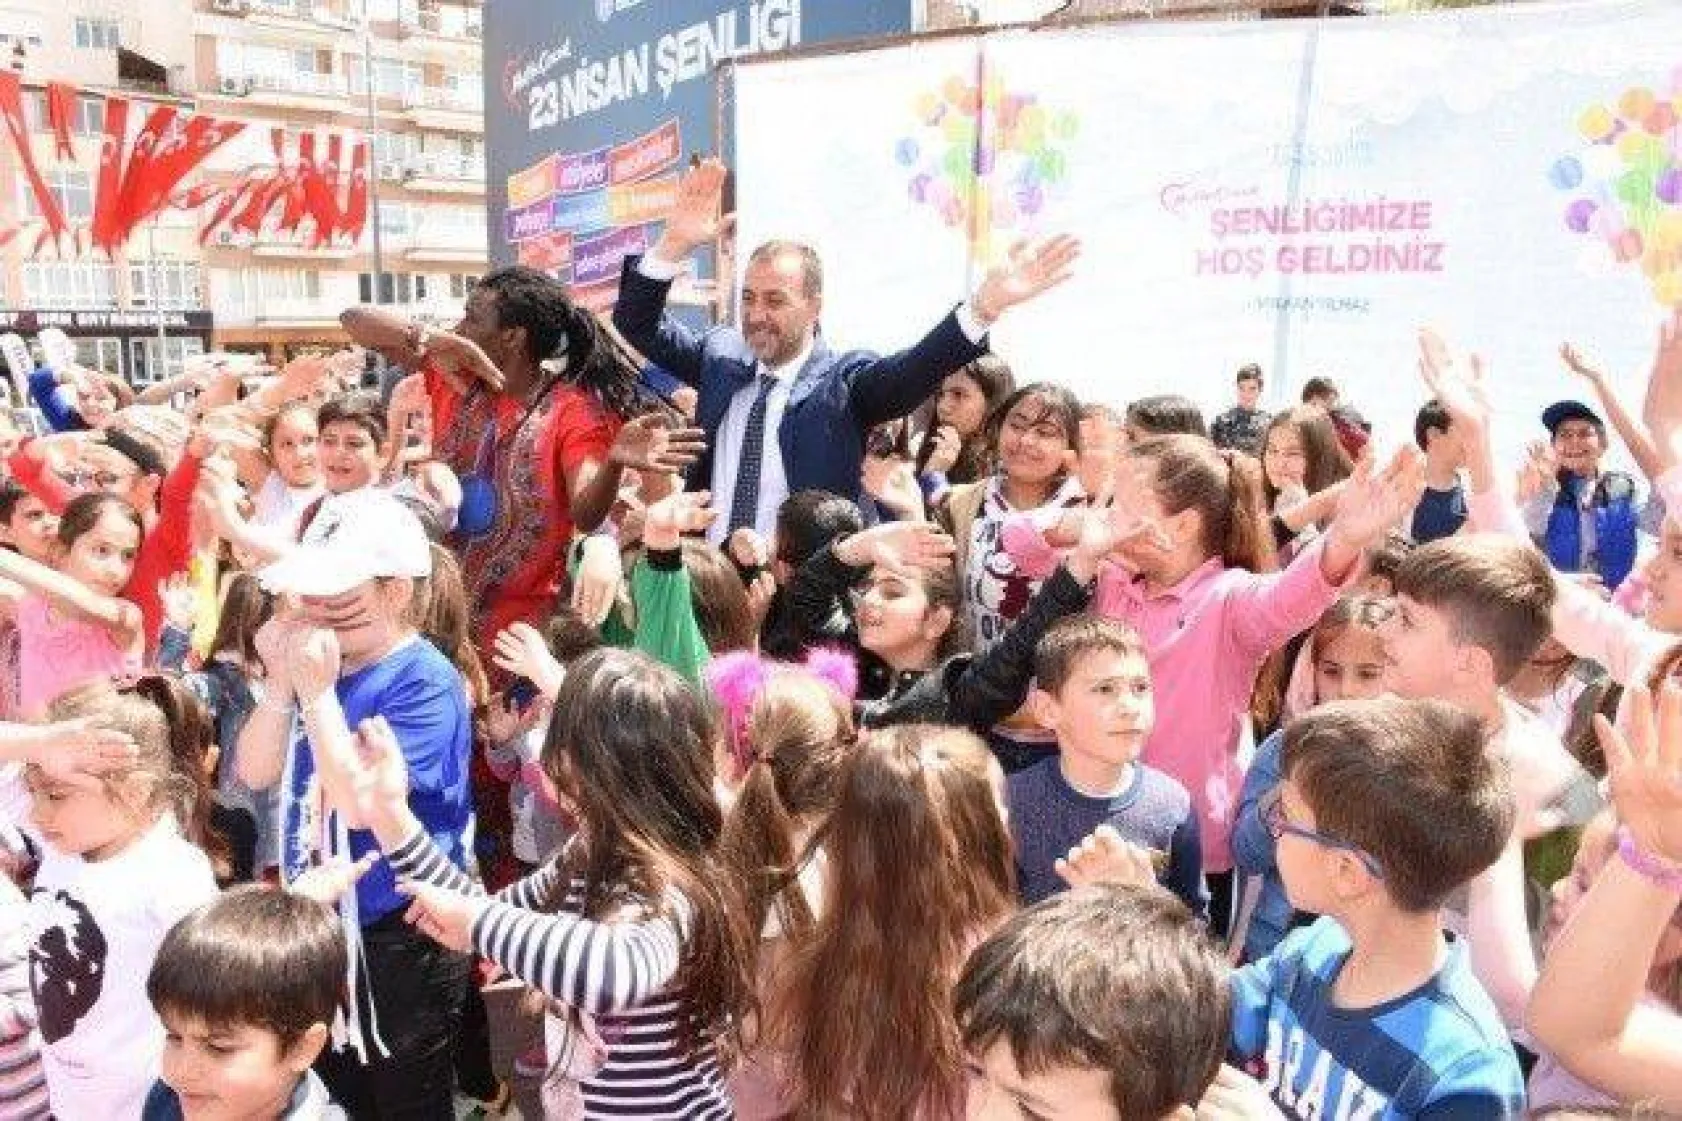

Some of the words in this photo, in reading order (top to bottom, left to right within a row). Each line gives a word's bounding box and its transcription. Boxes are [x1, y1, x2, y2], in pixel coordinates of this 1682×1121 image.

[528, 80, 559, 129] 23
[562, 44, 650, 117] NİSAN
[1210, 194, 1432, 241] ŞENLİĞİMİZE
[1196, 250, 1264, 280] HOŞ
[1275, 235, 1446, 275] GELDİNİZ
